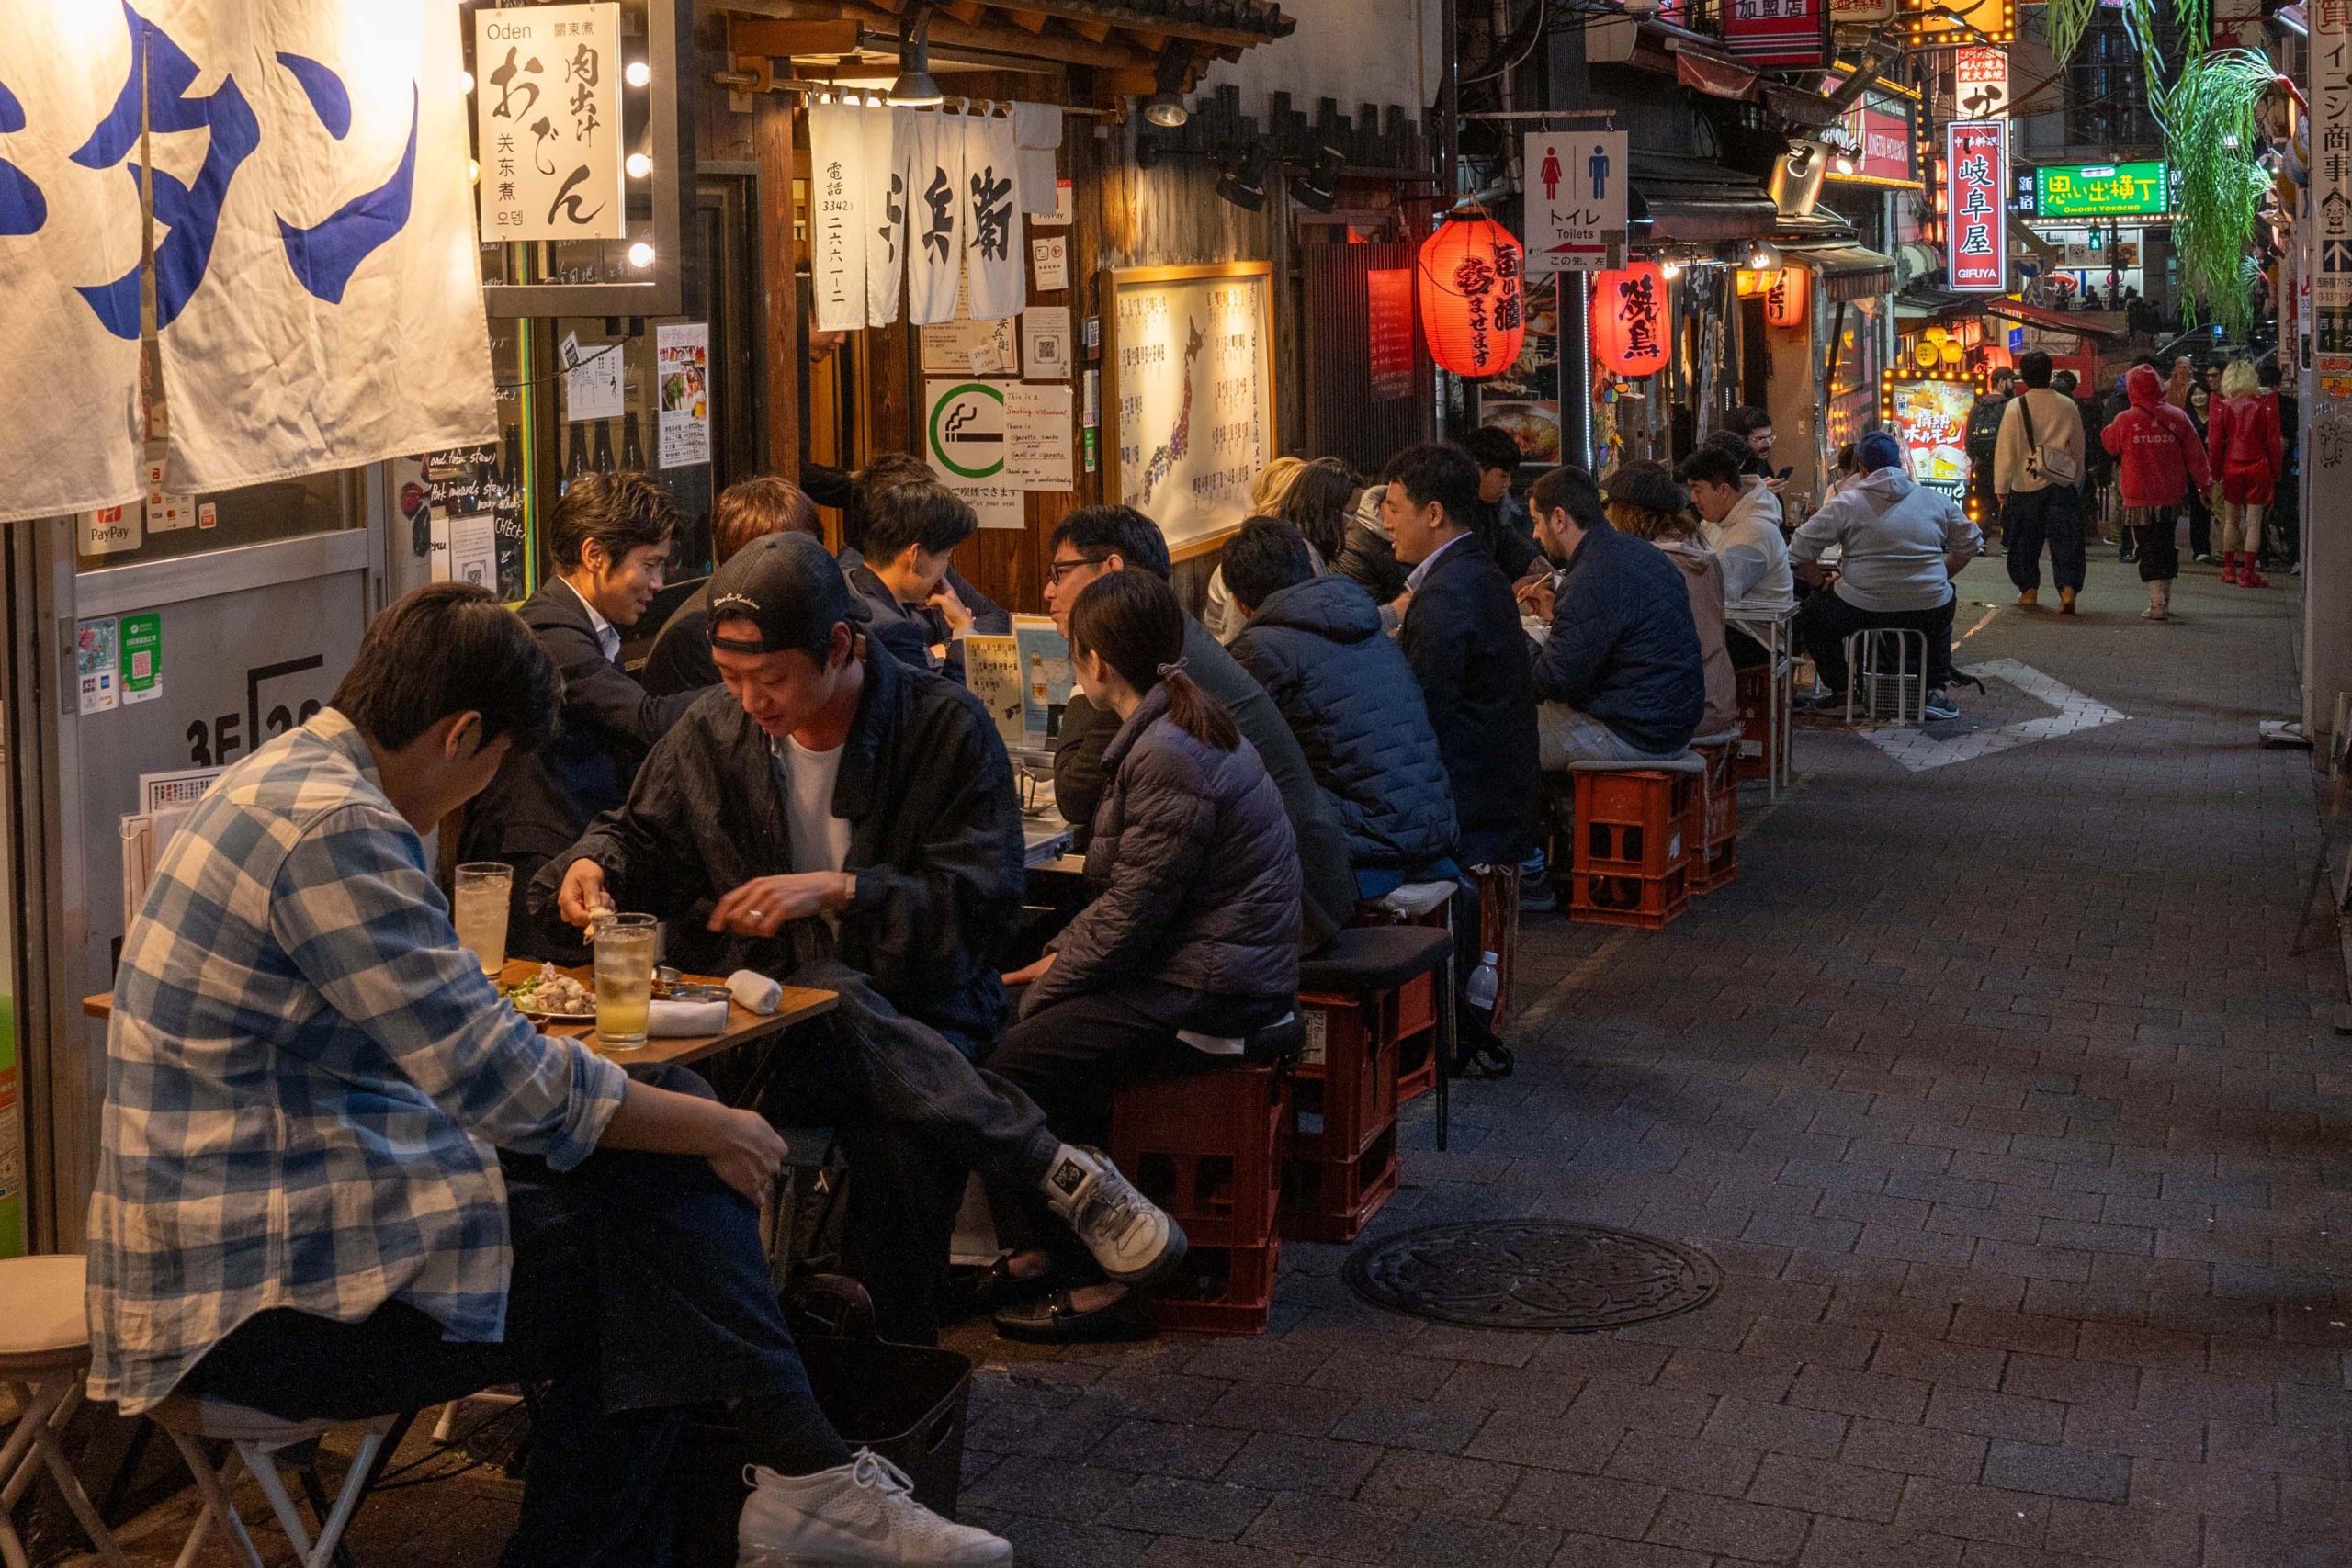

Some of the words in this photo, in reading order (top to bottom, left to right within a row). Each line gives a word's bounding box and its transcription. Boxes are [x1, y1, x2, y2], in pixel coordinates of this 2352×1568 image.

[1739, 0, 1803, 17] 加盟店
[487, 23, 532, 40] Oden
[565, 43, 601, 148] 肉出汁
[489, 45, 608, 227] おでん
[0, 0, 419, 341] タン
[497, 133, 516, 202] 关东煮
[2048, 175, 2157, 205] 思い出横丁
[1959, 154, 1995, 256] 岐阜屋
[496, 210, 524, 227] 오뎅
[1551, 209, 1600, 227] トイレ
[1556, 229, 1594, 239] Toilets
[1550, 256, 1605, 266] この先、左
[1958, 268, 1997, 279] GIFUYA
[1620, 273, 1661, 360] 焼鳥
[1916, 411, 1951, 430] 情熱
[1904, 424, 1962, 444] ホルモン
[2133, 434, 2176, 444] STUDIO
[91, 525, 130, 543] PayPay
[429, 540, 447, 551] enu
